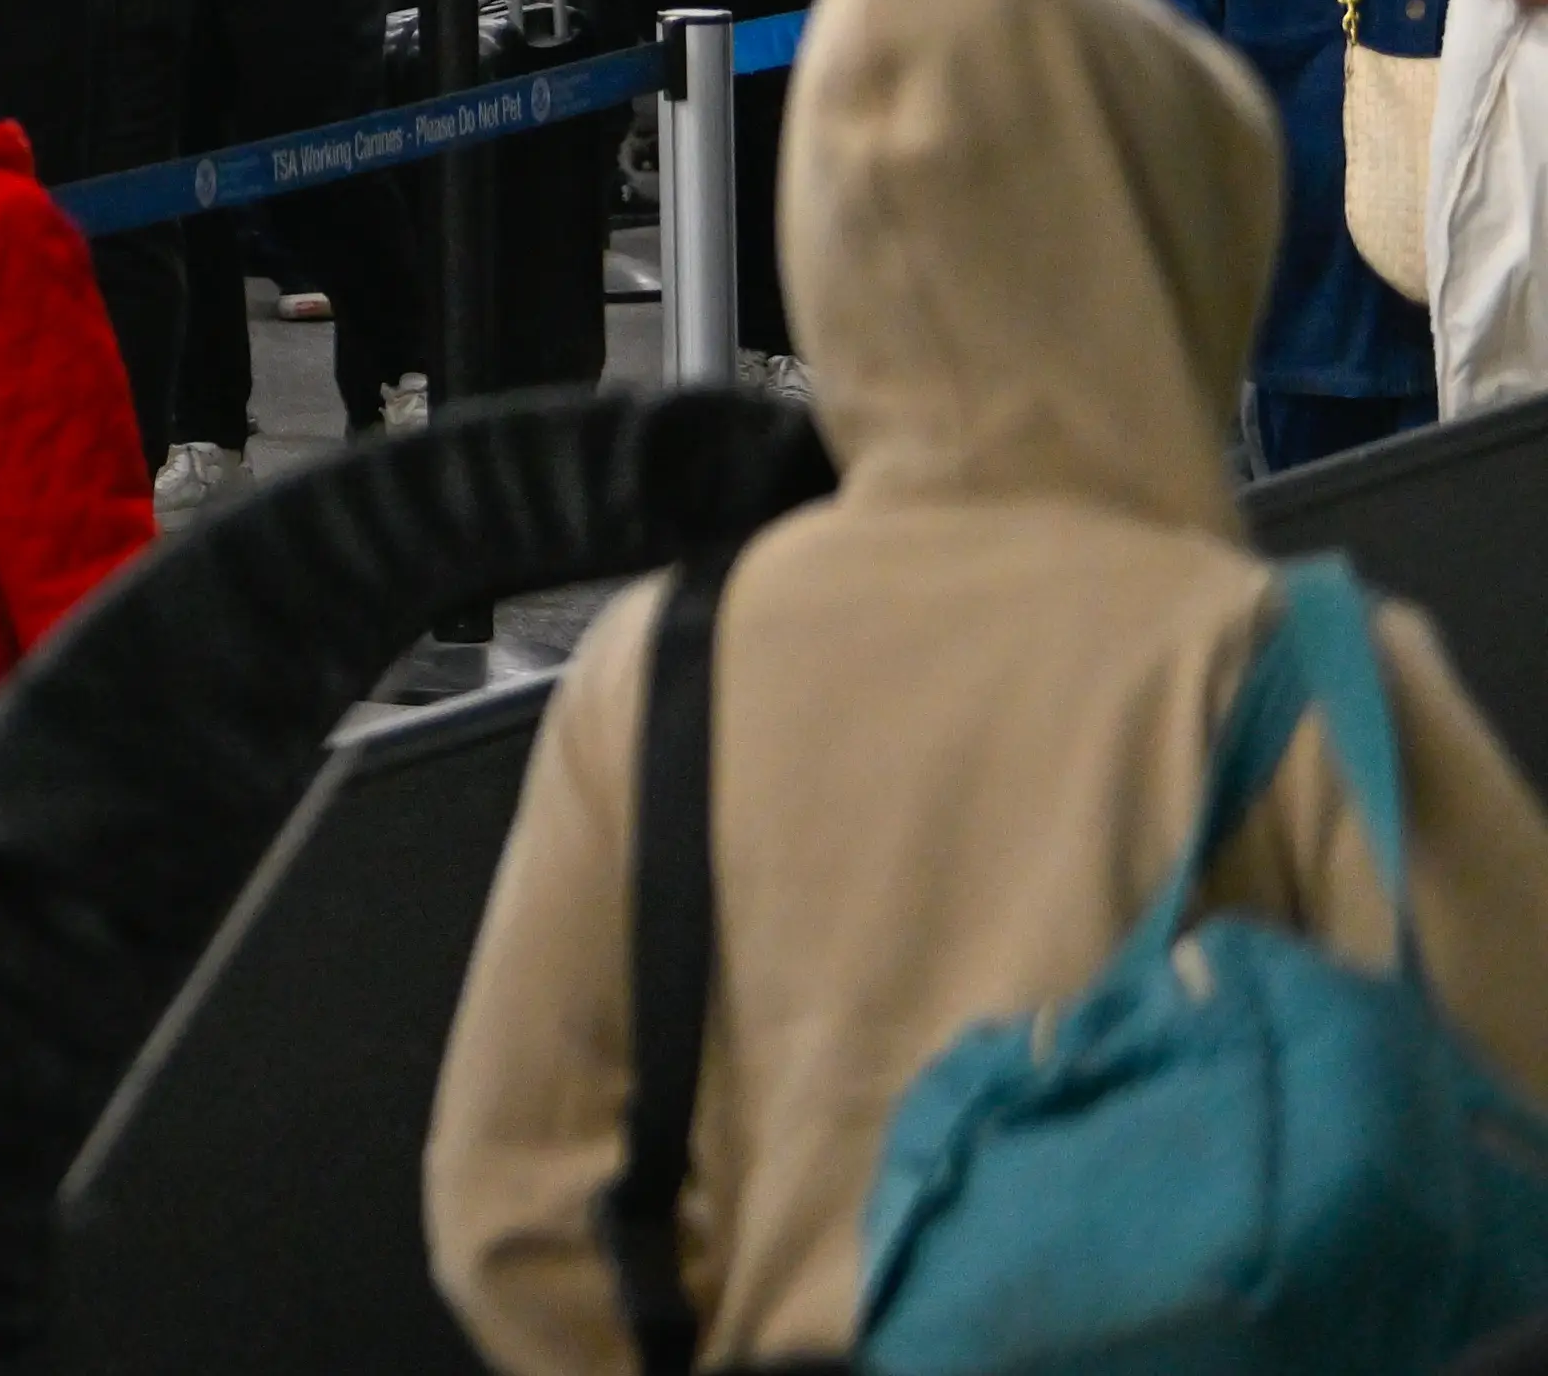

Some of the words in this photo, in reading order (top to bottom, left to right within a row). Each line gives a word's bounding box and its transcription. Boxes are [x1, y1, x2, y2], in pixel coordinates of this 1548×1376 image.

[272, 152, 299, 182] TSA
[300, 139, 353, 177] Working
[355, 126, 403, 161] Canines
[415, 114, 455, 145] Please
[458, 104, 475, 135] Do
[478, 98, 500, 129] Not
[502, 91, 523, 123] Pet
